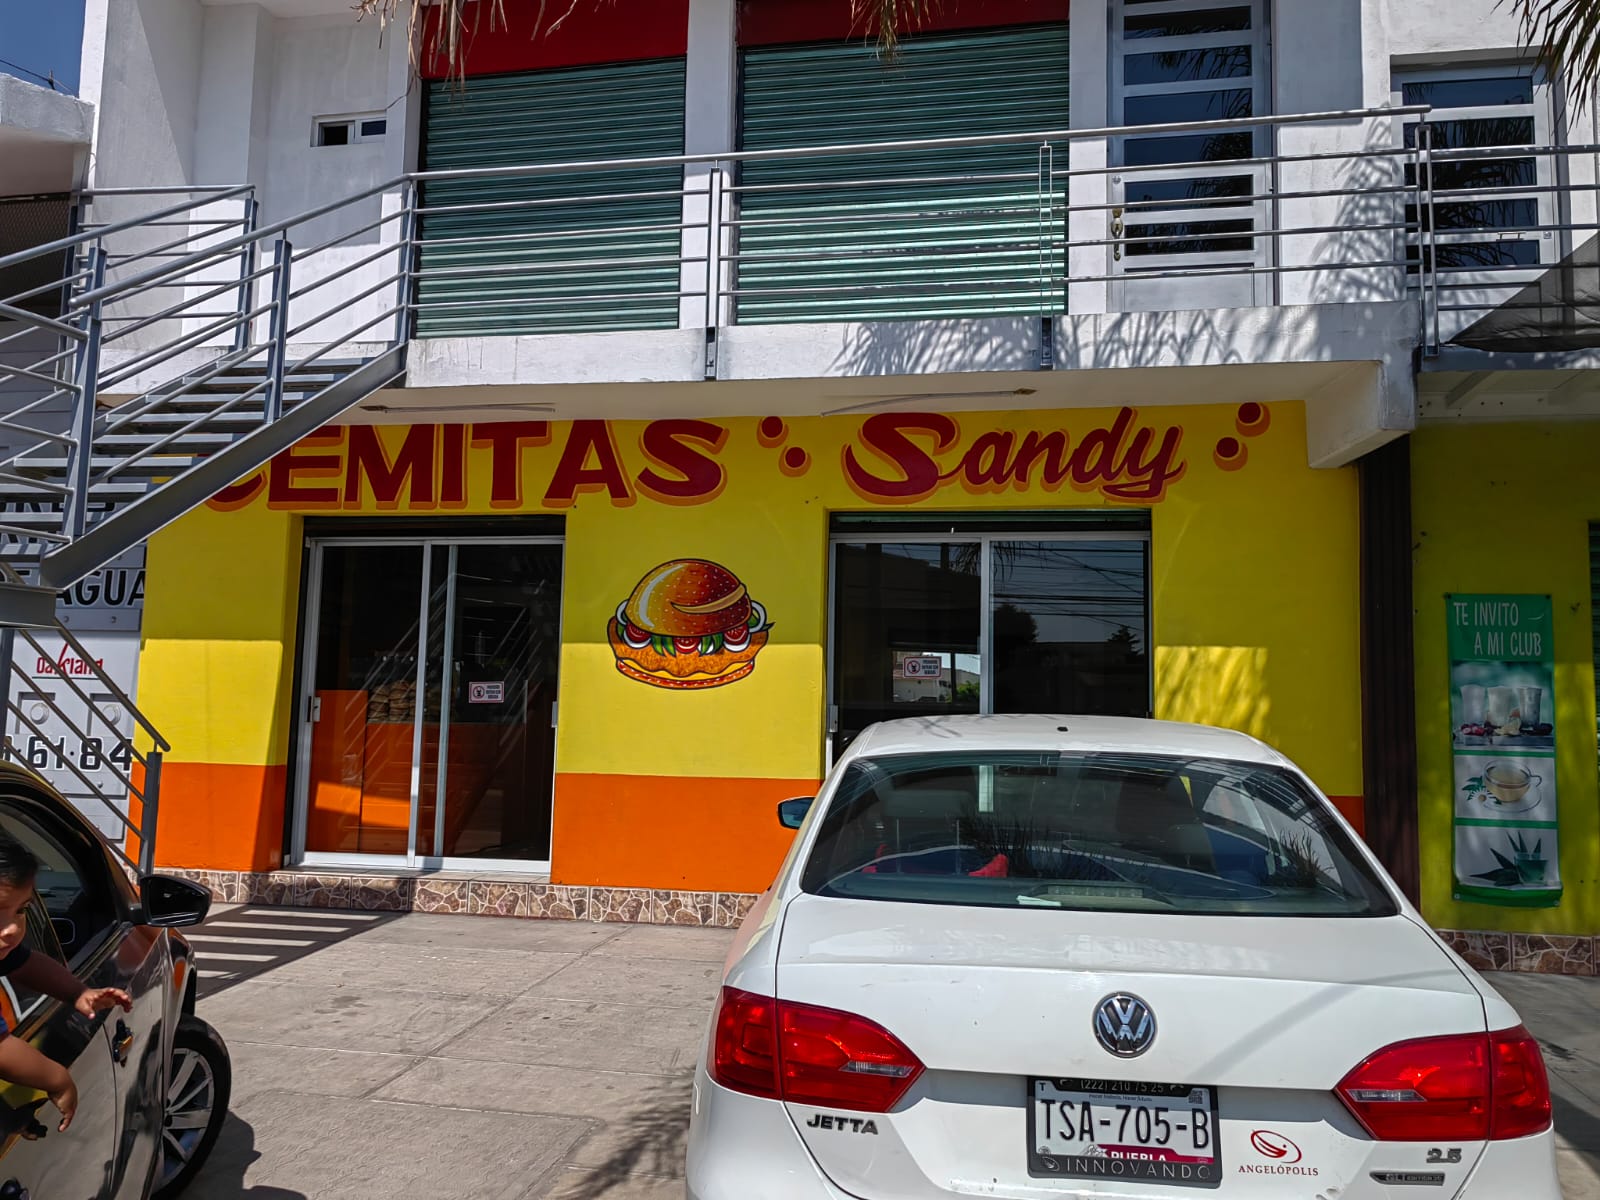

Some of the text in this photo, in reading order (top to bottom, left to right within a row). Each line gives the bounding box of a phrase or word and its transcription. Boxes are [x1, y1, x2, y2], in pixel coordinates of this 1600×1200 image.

[204, 406, 1187, 513] EMITAS Sandy
[1453, 602, 1519, 626] TE INVITO
[1474, 631, 1542, 656] A MI CLUB
[807, 1114, 878, 1135] JETTA
[1041, 1099, 1209, 1149] TSA-705-B
[1066, 1158, 1211, 1180] INNOVANDO
[1238, 1164, 1319, 1176] ANGELÓPOLIS
